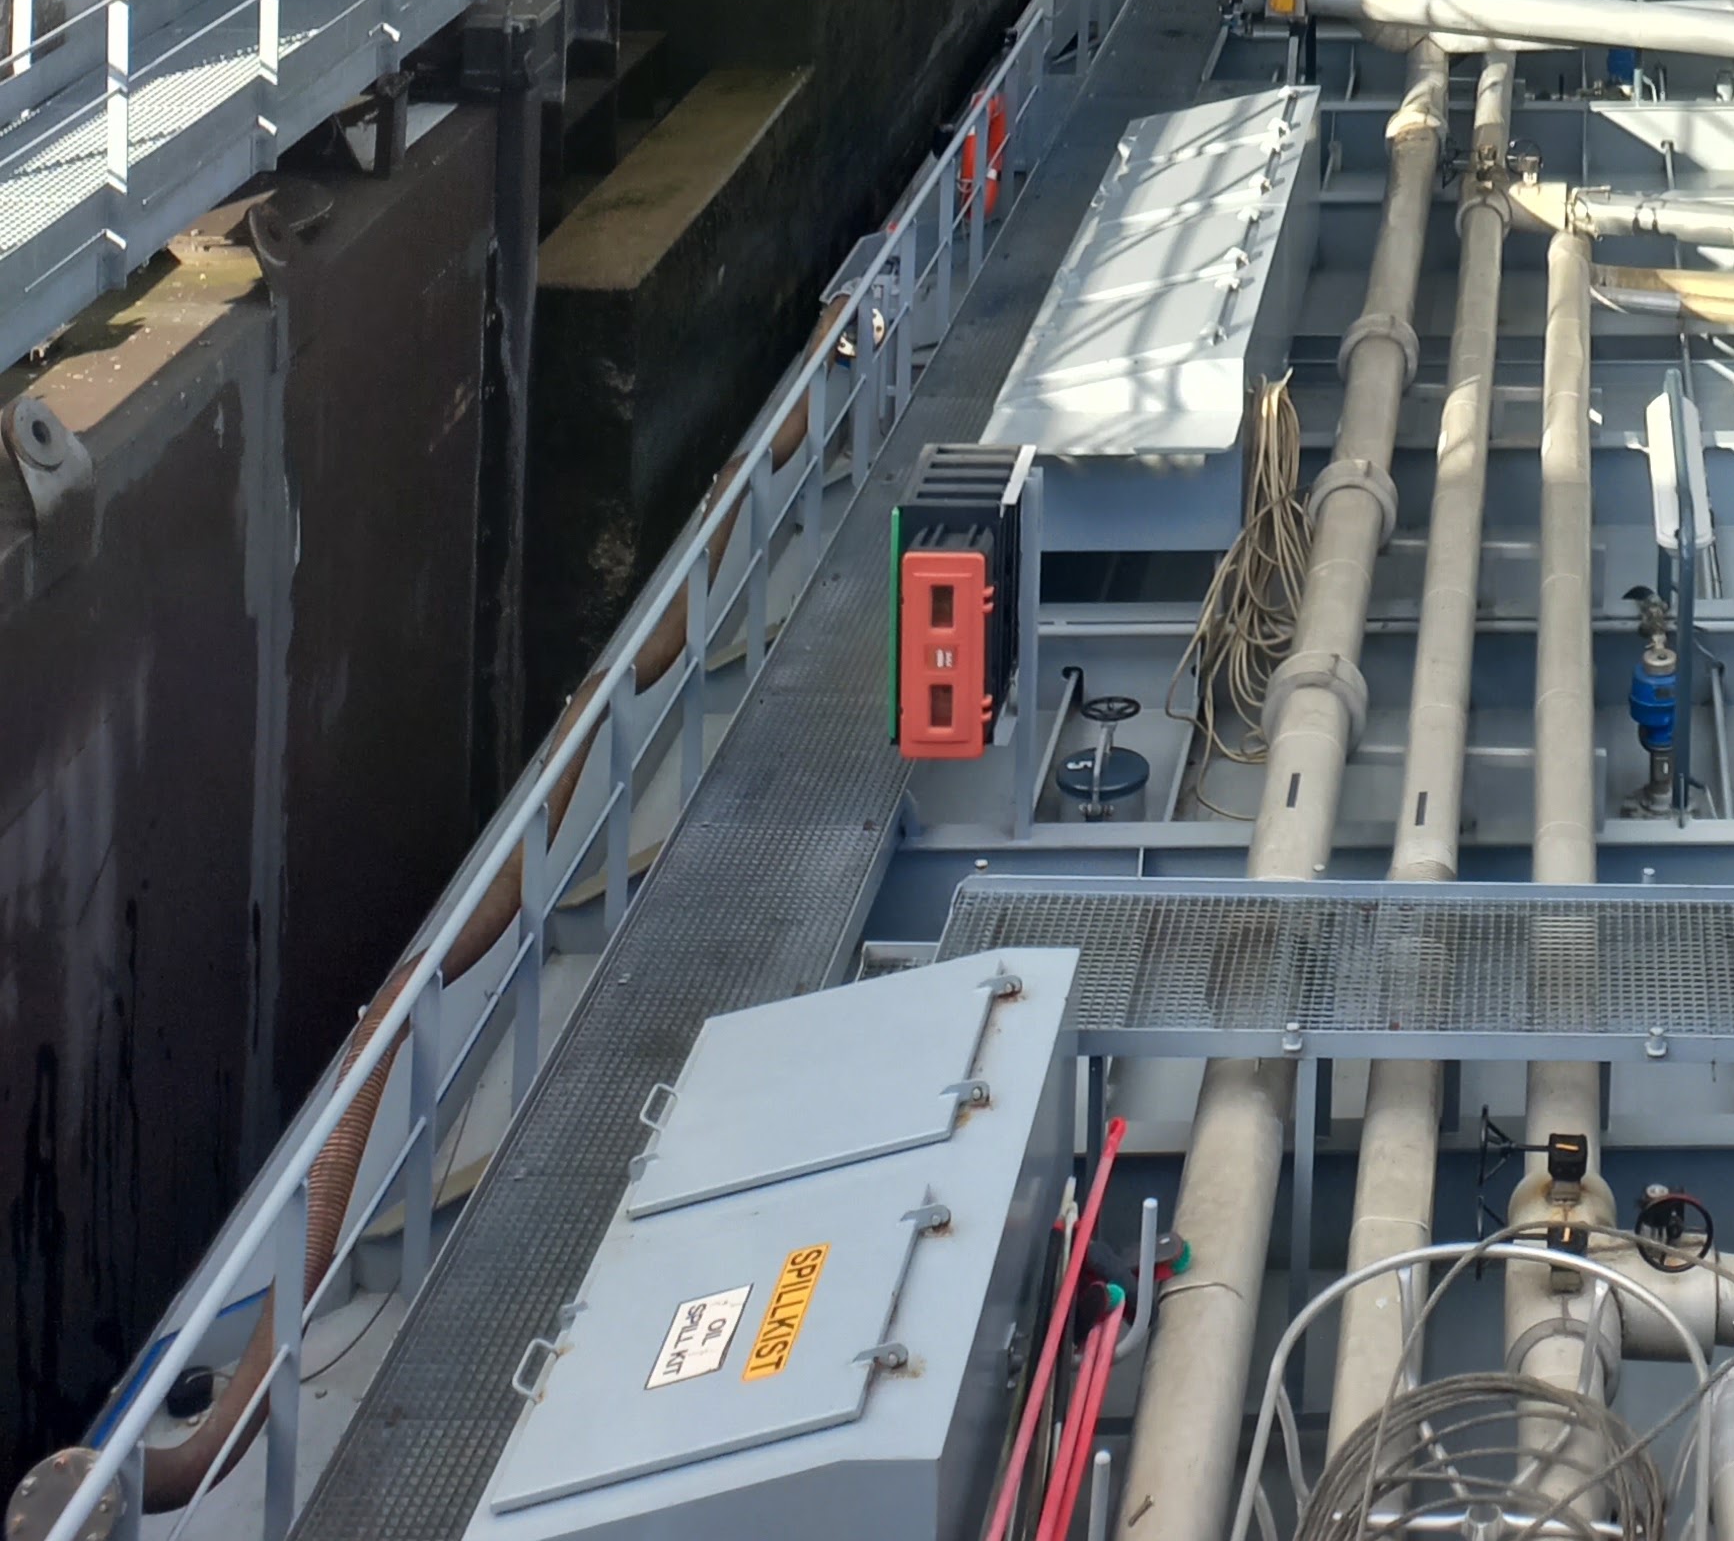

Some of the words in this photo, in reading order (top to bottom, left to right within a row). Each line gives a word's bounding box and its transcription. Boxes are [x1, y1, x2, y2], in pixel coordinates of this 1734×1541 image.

[673, 1303, 708, 1349] SPILL
[701, 1318, 727, 1347] OIL
[662, 1349, 690, 1376] KIT
